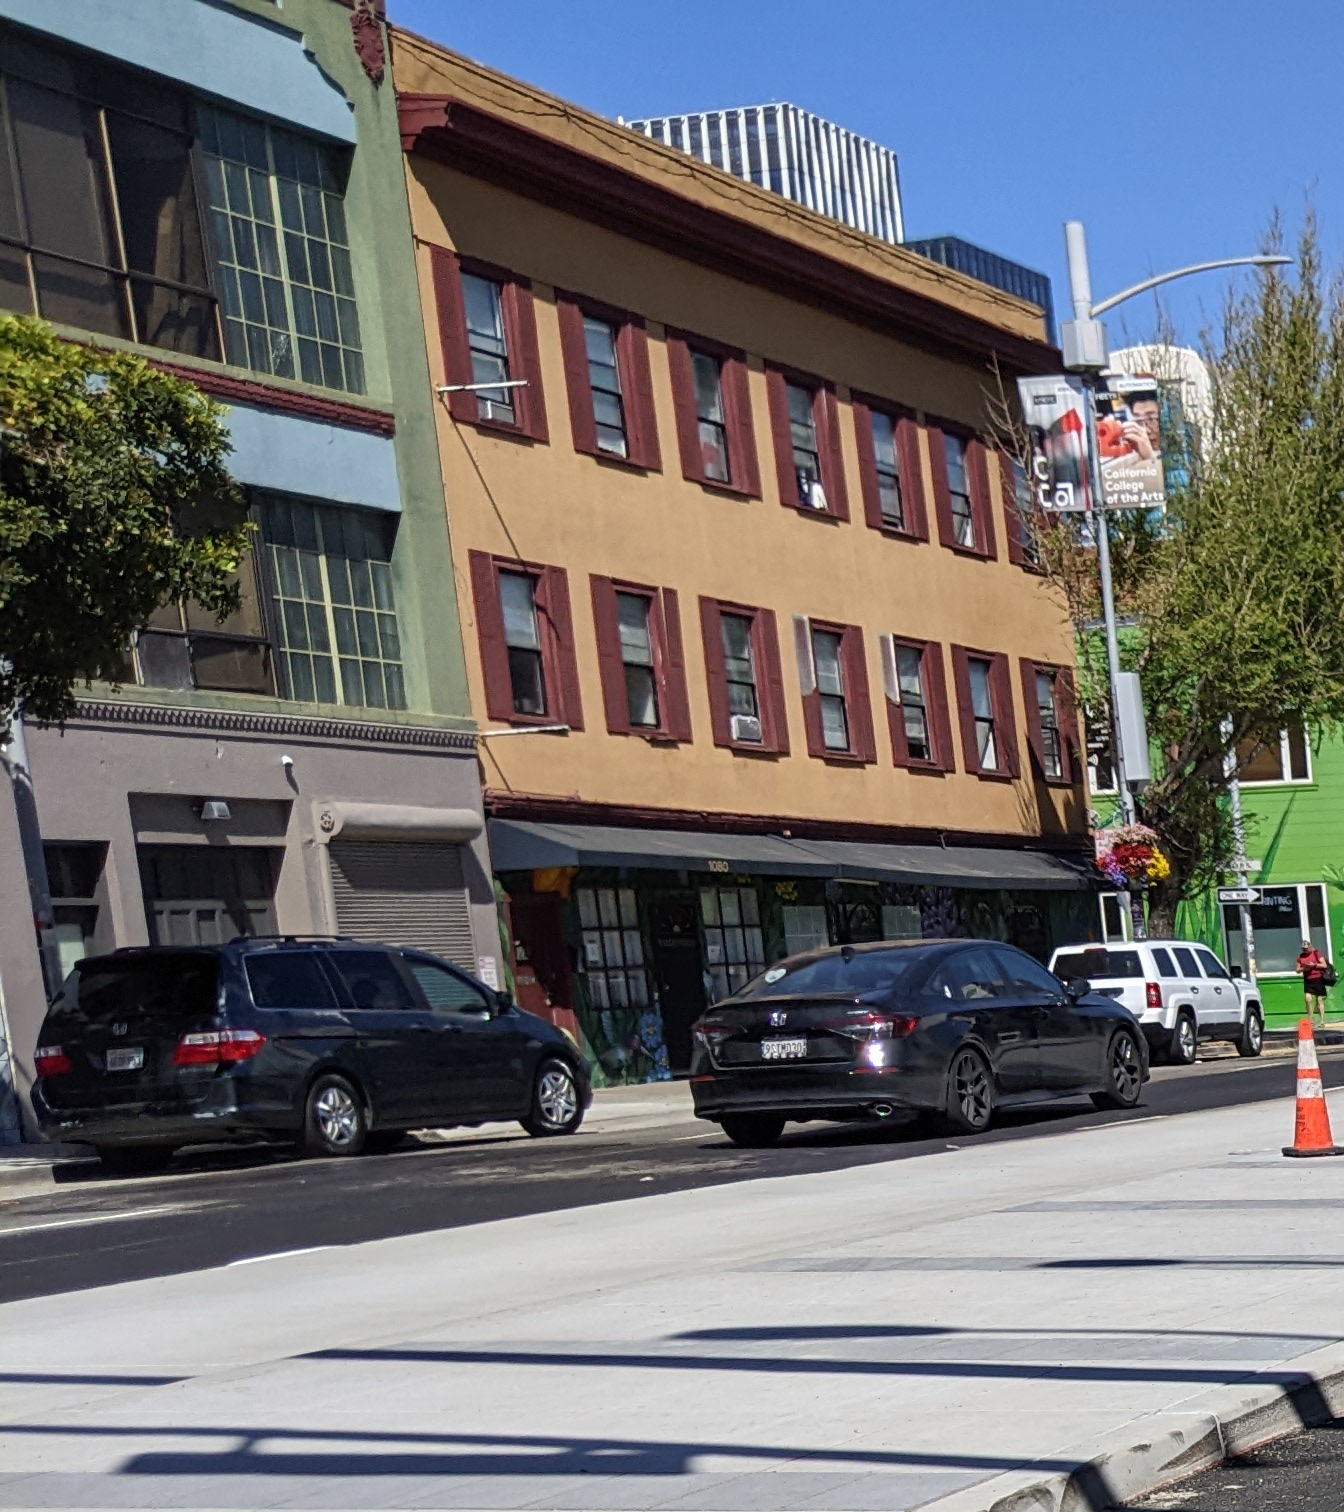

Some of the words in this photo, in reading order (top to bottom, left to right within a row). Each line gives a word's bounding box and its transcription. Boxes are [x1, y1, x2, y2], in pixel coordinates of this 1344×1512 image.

[1104, 467, 1157, 480] California
[1105, 480, 1145, 492] College
[1106, 494, 1119, 505] of
[1120, 492, 1139, 504] the
[1141, 490, 1164, 502] Arts
[708, 860, 729, 873] 1080
